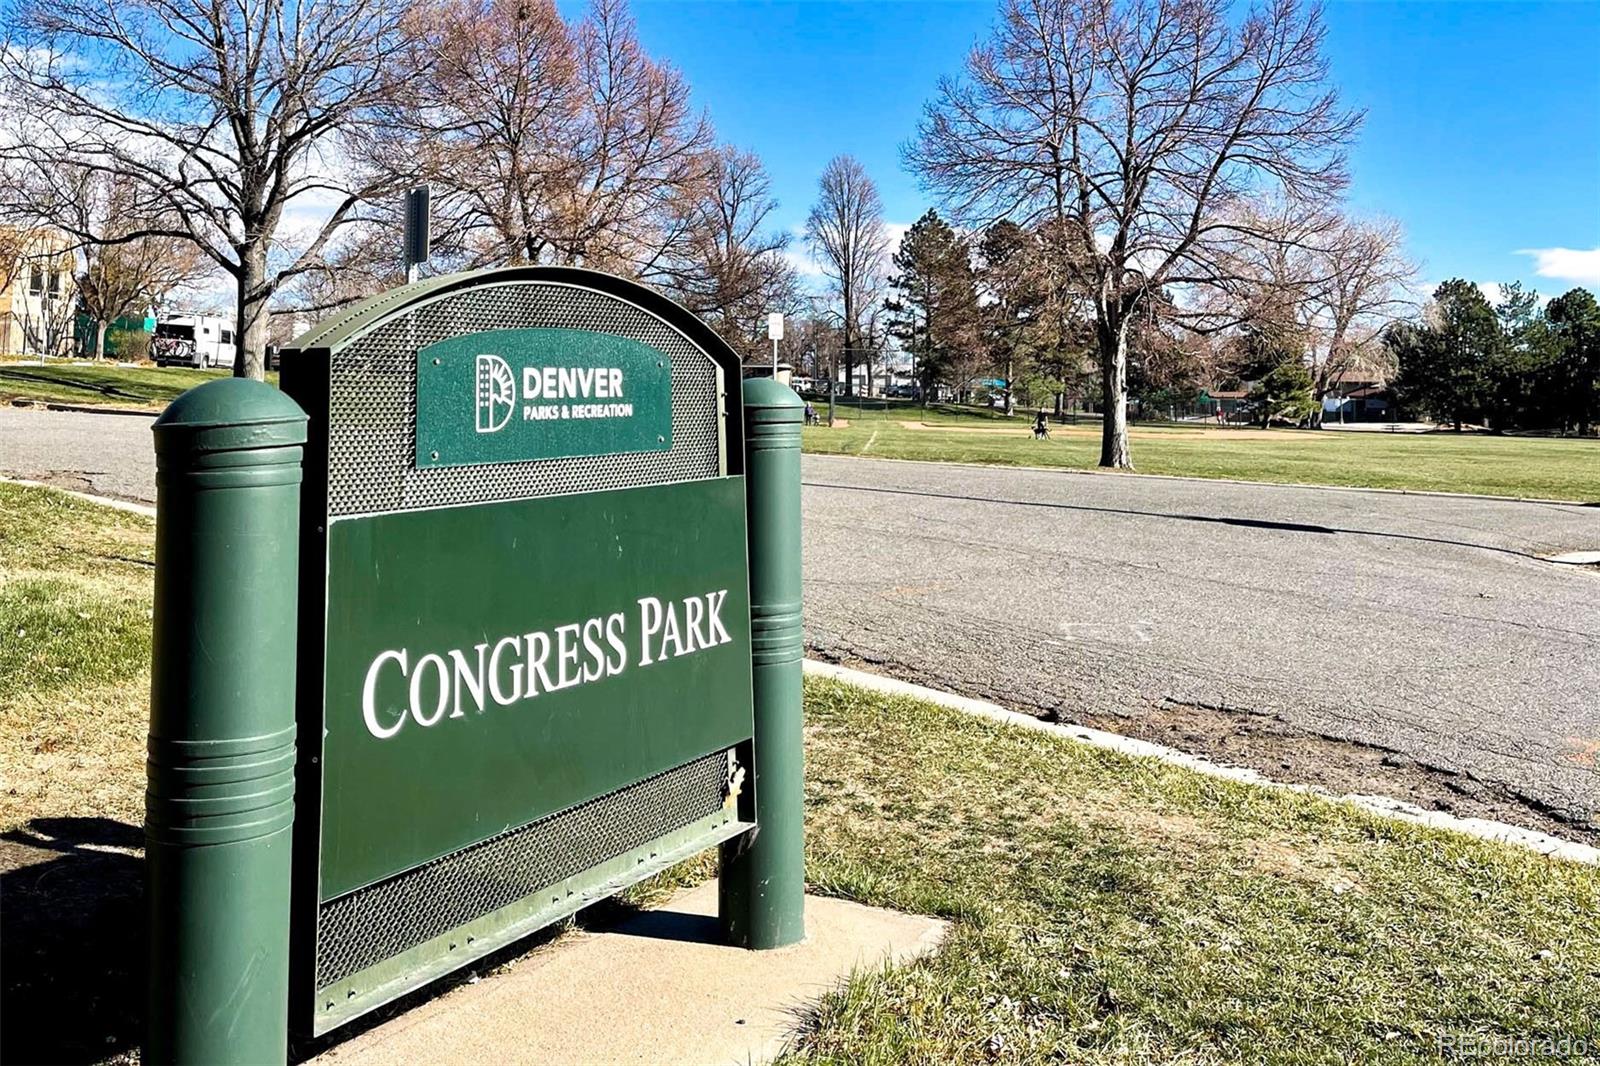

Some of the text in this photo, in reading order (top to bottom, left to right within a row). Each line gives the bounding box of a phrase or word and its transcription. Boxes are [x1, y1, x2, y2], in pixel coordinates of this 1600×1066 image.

[522, 367, 623, 400] DENVER
[523, 404, 633, 421] PARKS & RECREATION
